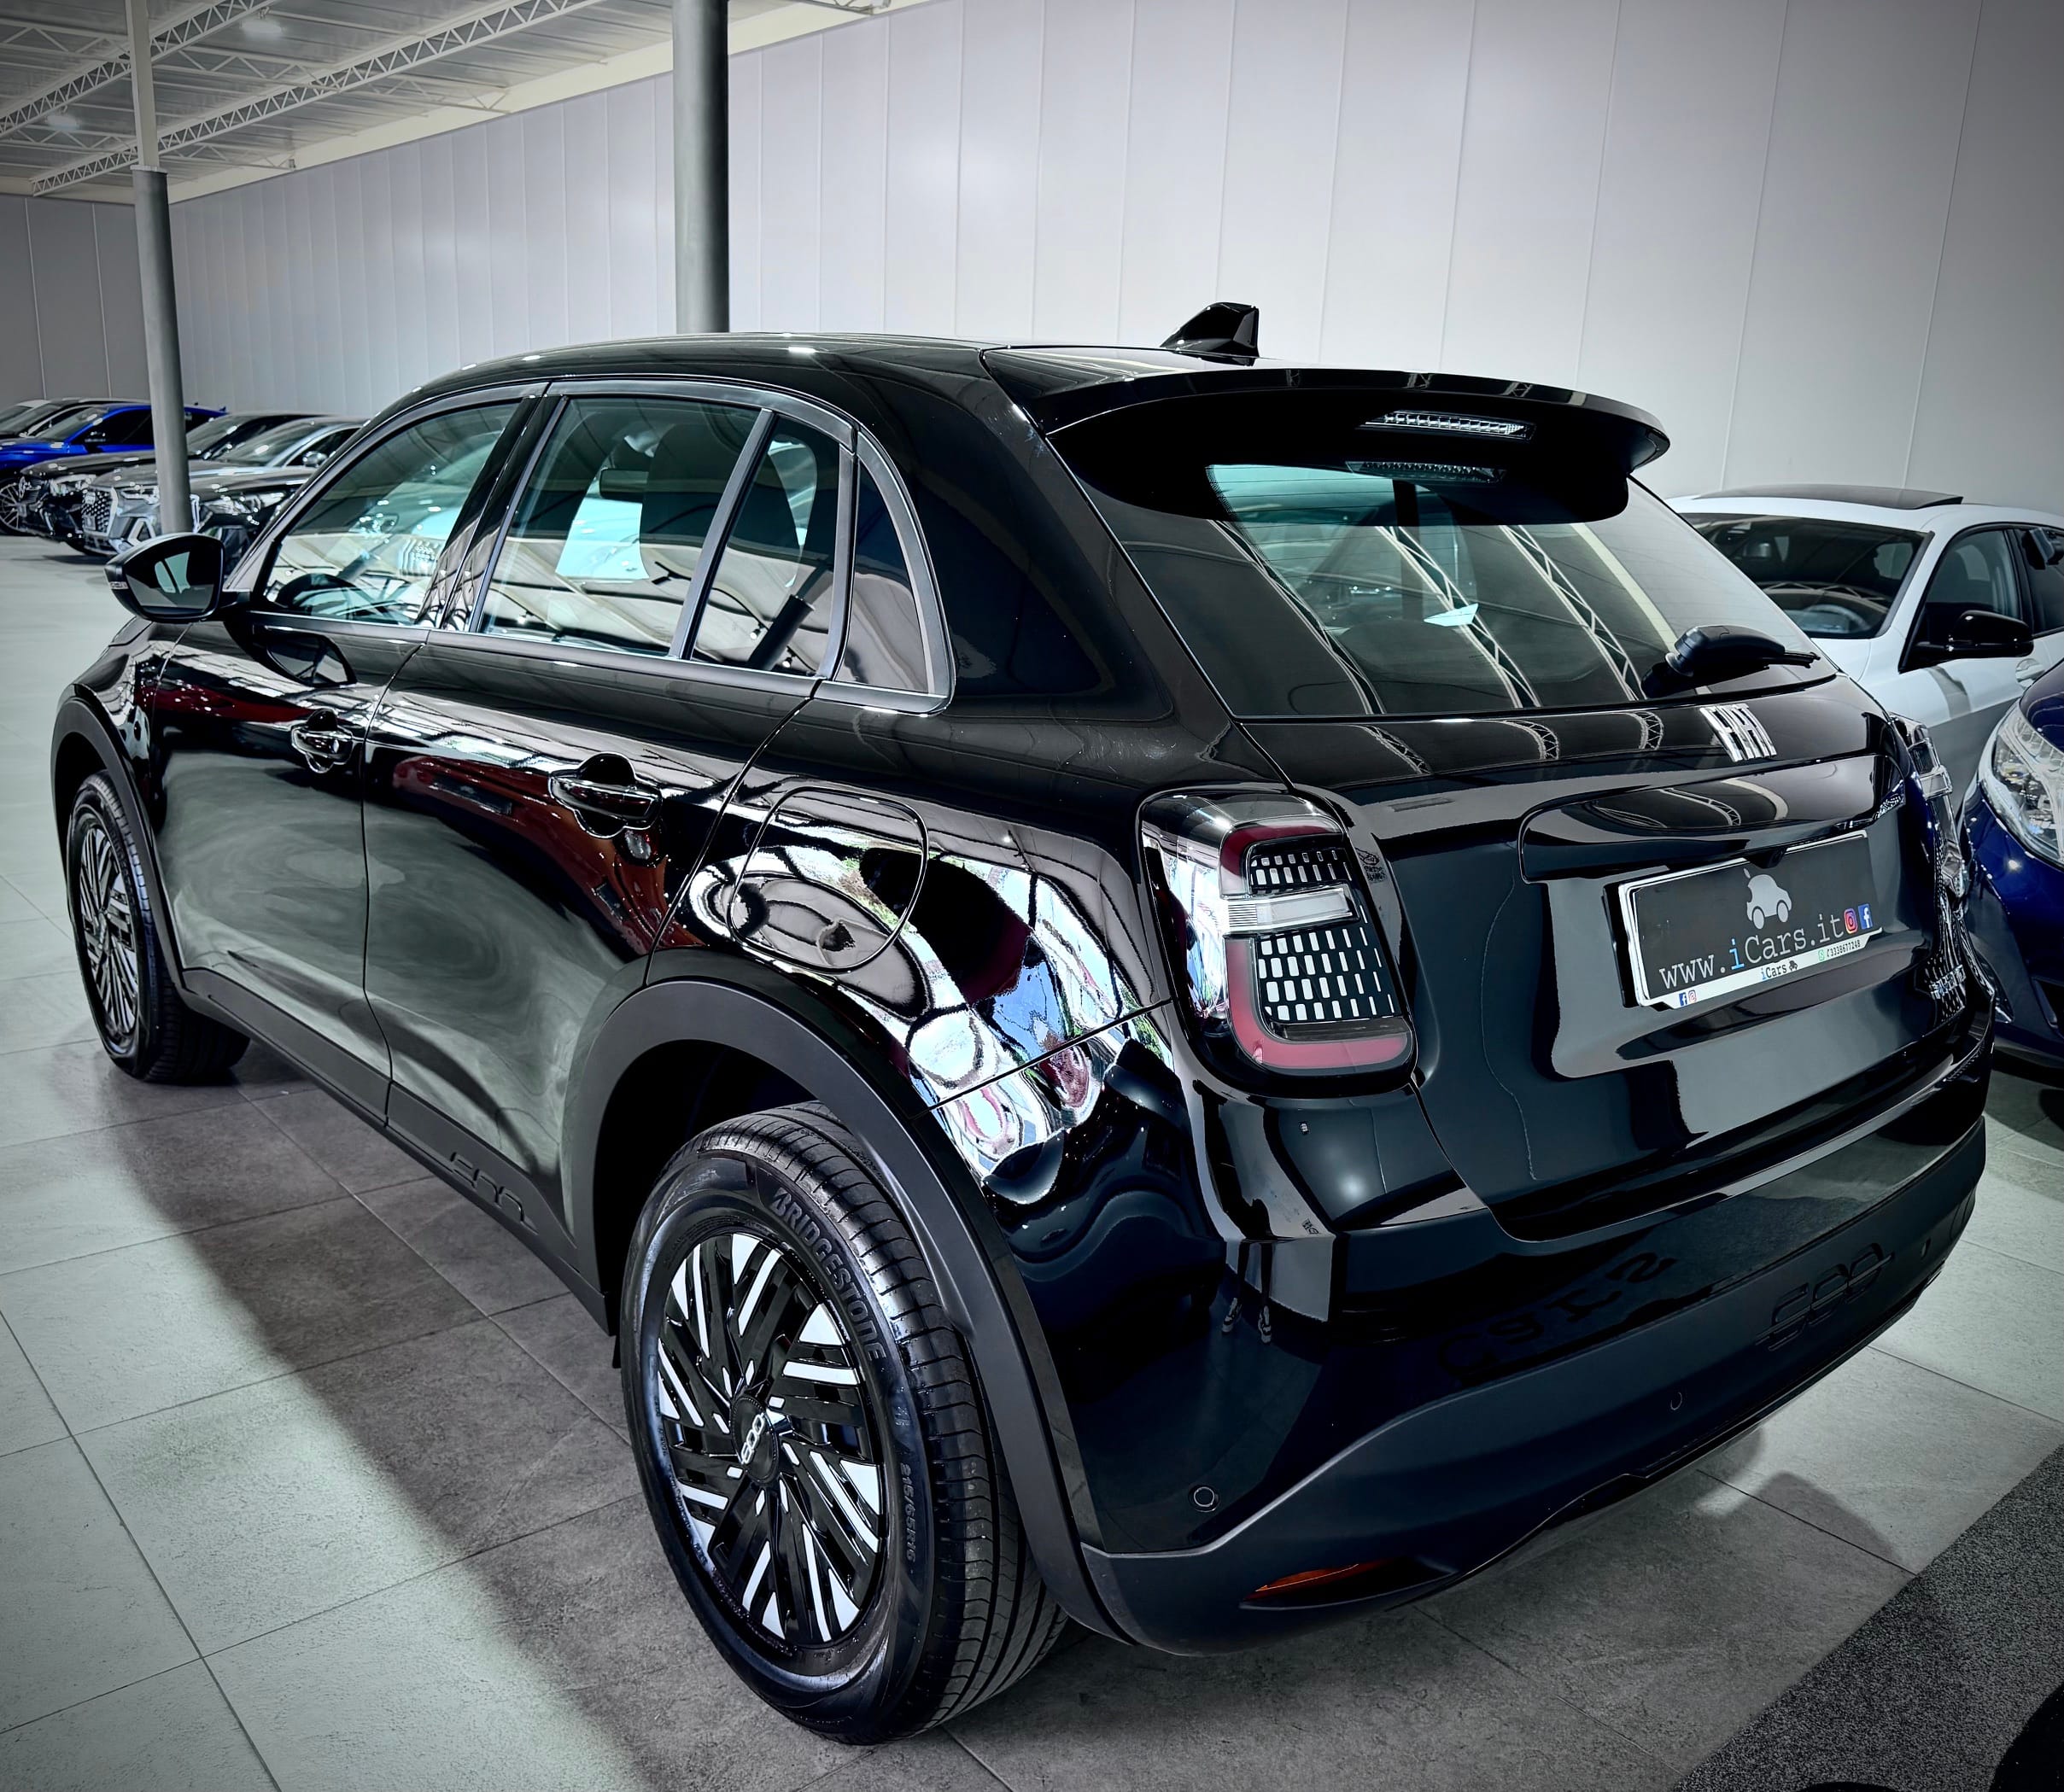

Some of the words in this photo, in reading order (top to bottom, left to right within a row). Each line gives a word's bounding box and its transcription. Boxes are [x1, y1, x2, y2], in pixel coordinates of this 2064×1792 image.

[1699, 703, 1777, 762] FIAT
[1659, 912, 1844, 989] www.iCars.it
[1761, 964, 1787, 980] iCars
[769, 1186, 887, 1363] BRIDGESTONE
[740, 1411, 765, 1465] 600
